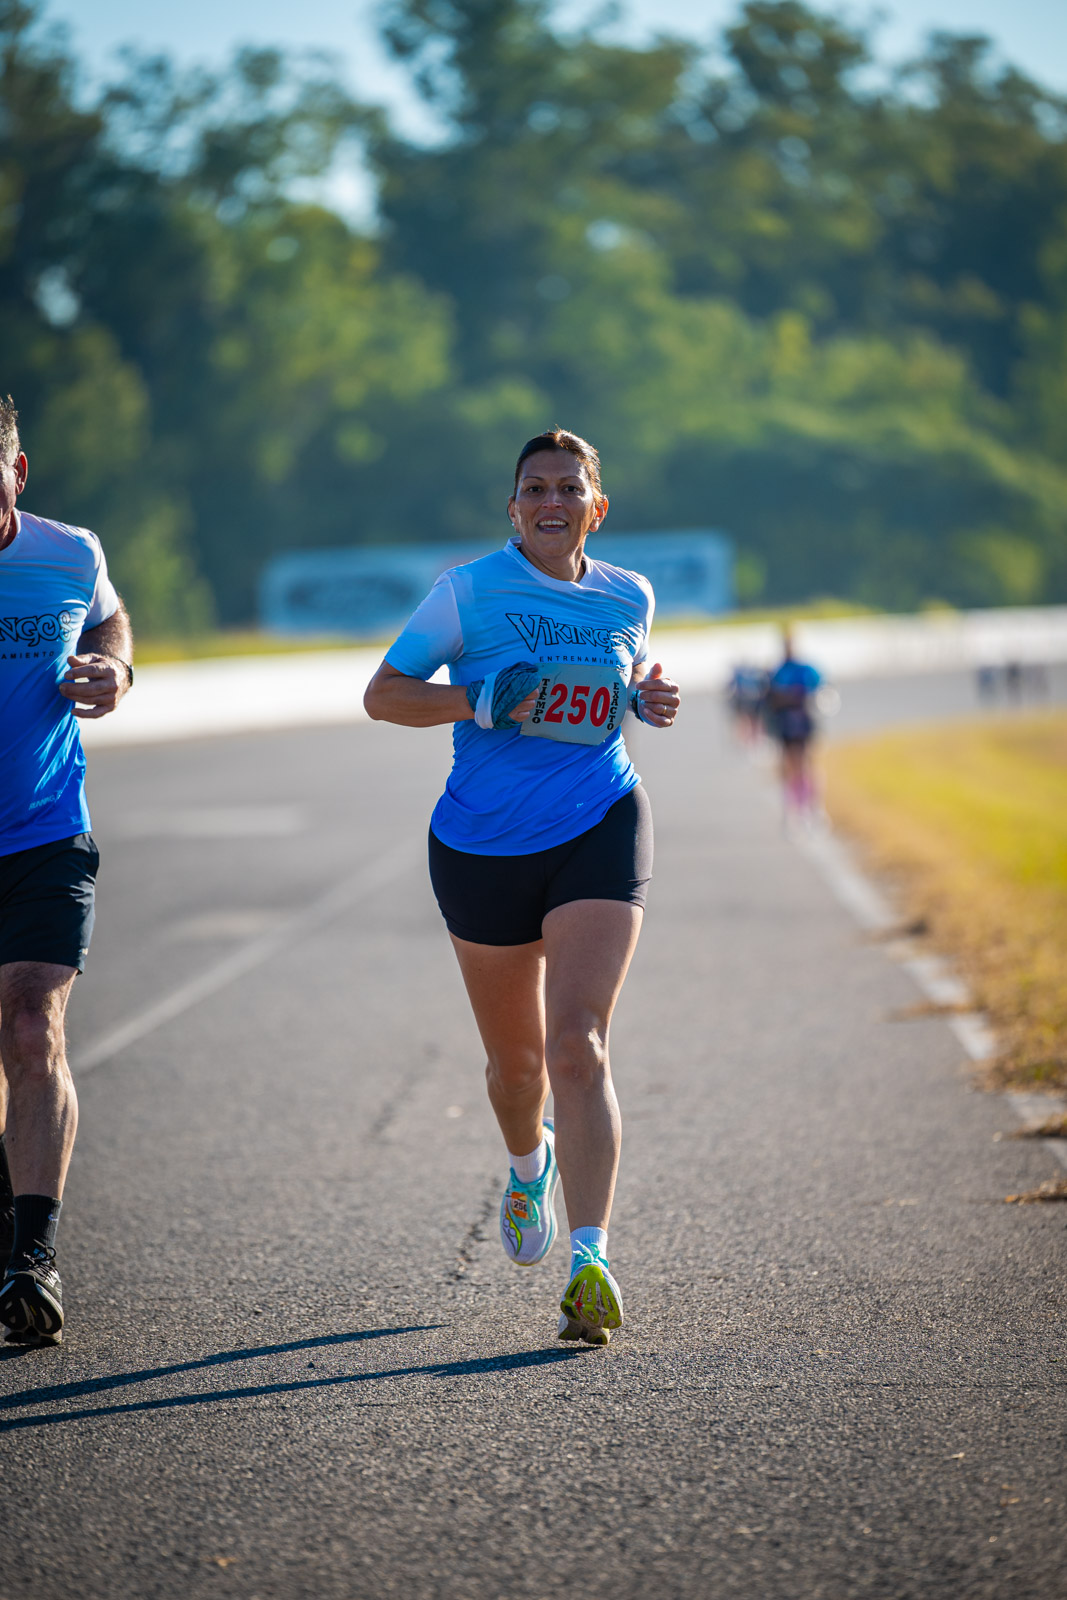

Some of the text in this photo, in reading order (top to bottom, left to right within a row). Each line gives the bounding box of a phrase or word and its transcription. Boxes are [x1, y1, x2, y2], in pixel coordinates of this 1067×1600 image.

[539, 655, 624, 667] ENTRENAMIENTO
[532, 678, 550, 724] TIEMPO
[543, 683, 611, 728] 250
[606, 682, 620, 731] EXACTO
